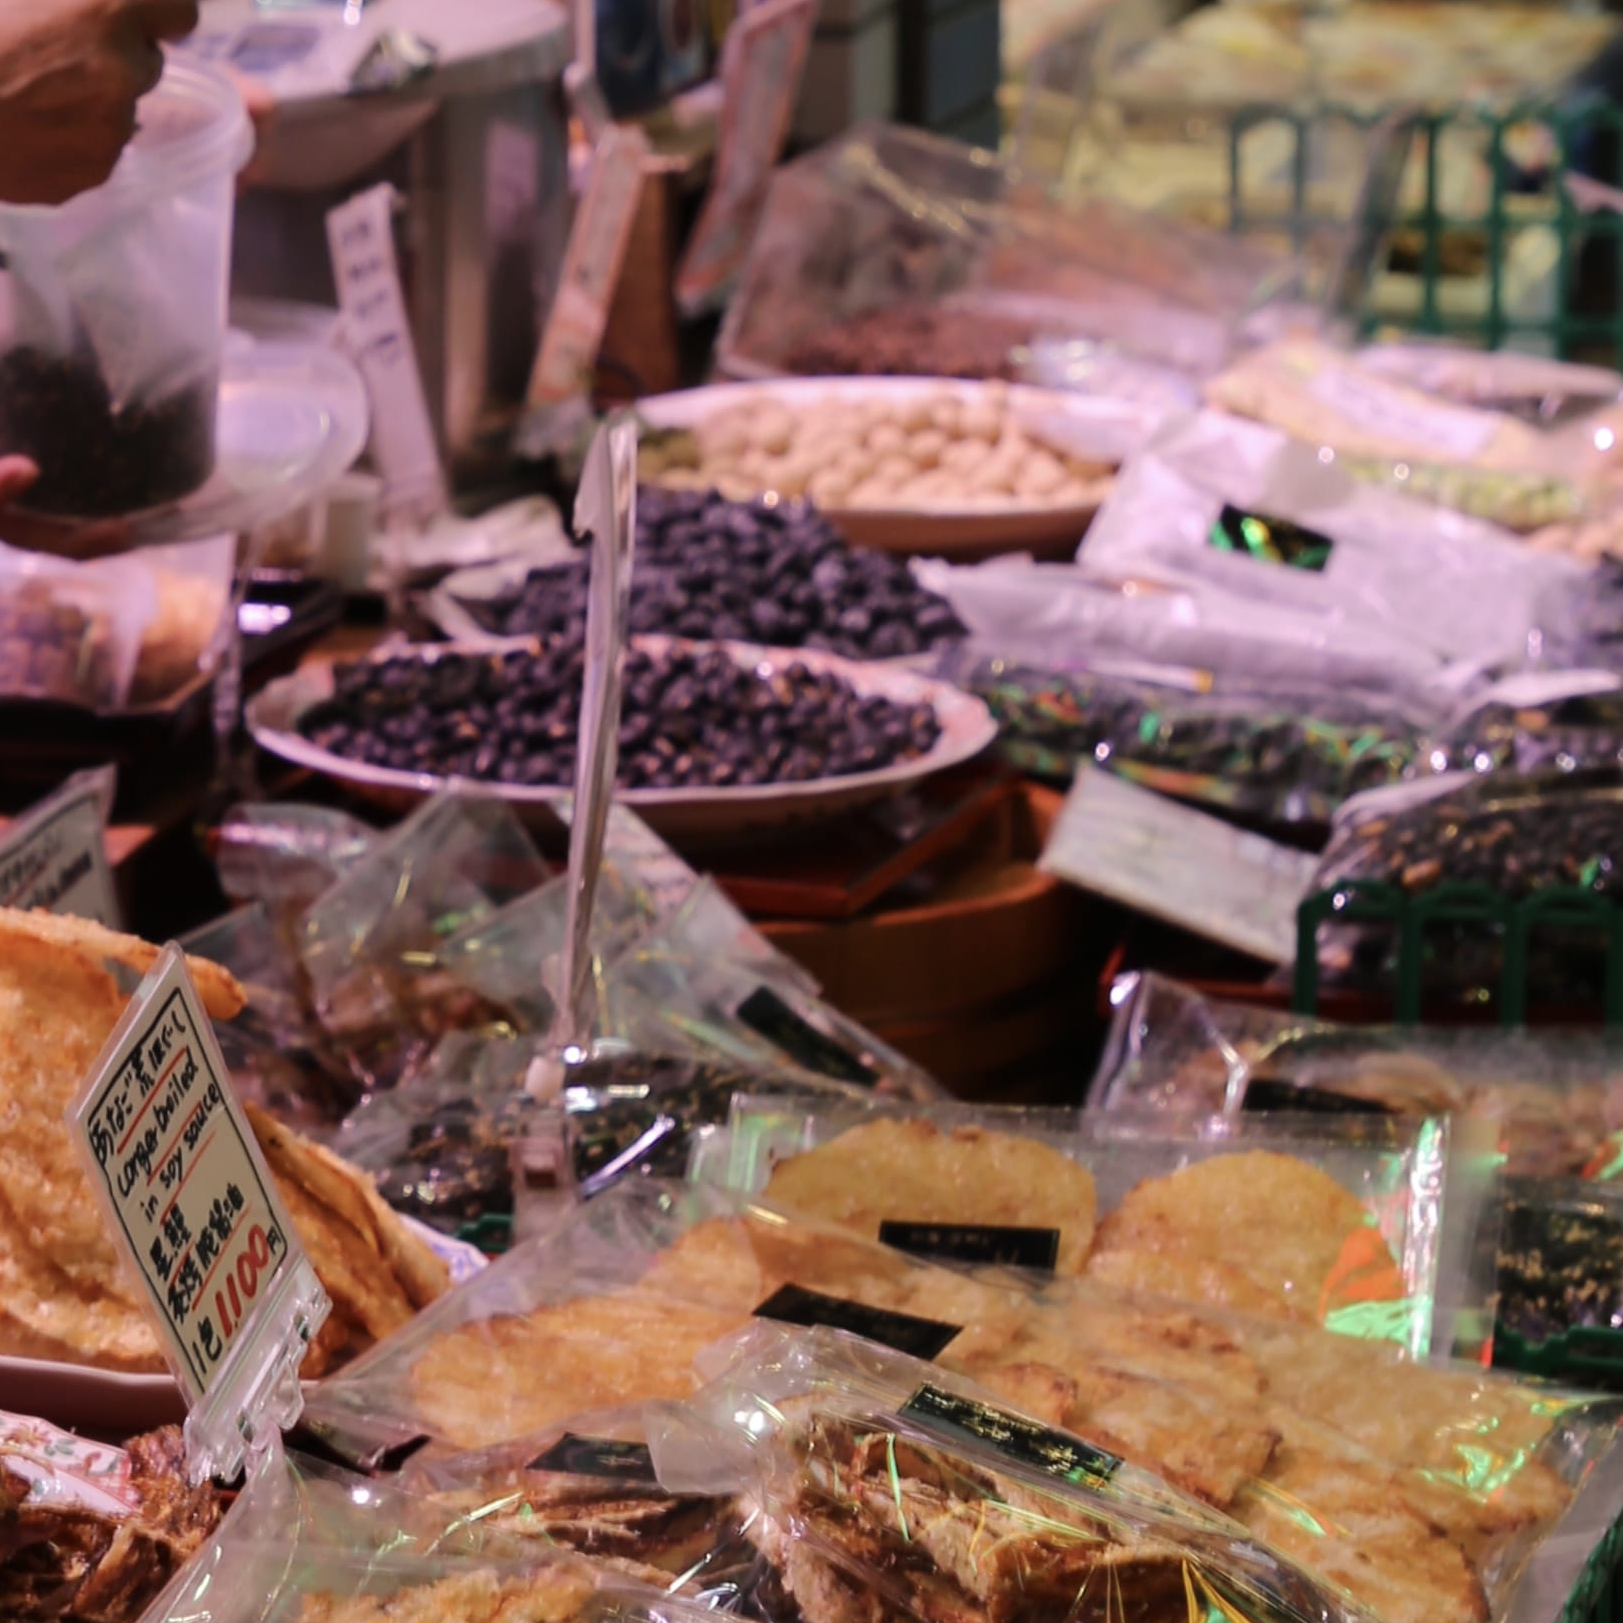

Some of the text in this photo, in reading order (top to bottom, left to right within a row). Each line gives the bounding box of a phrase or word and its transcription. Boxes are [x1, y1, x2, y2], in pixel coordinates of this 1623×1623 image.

[141, 1083, 220, 1224] in soy sauce
